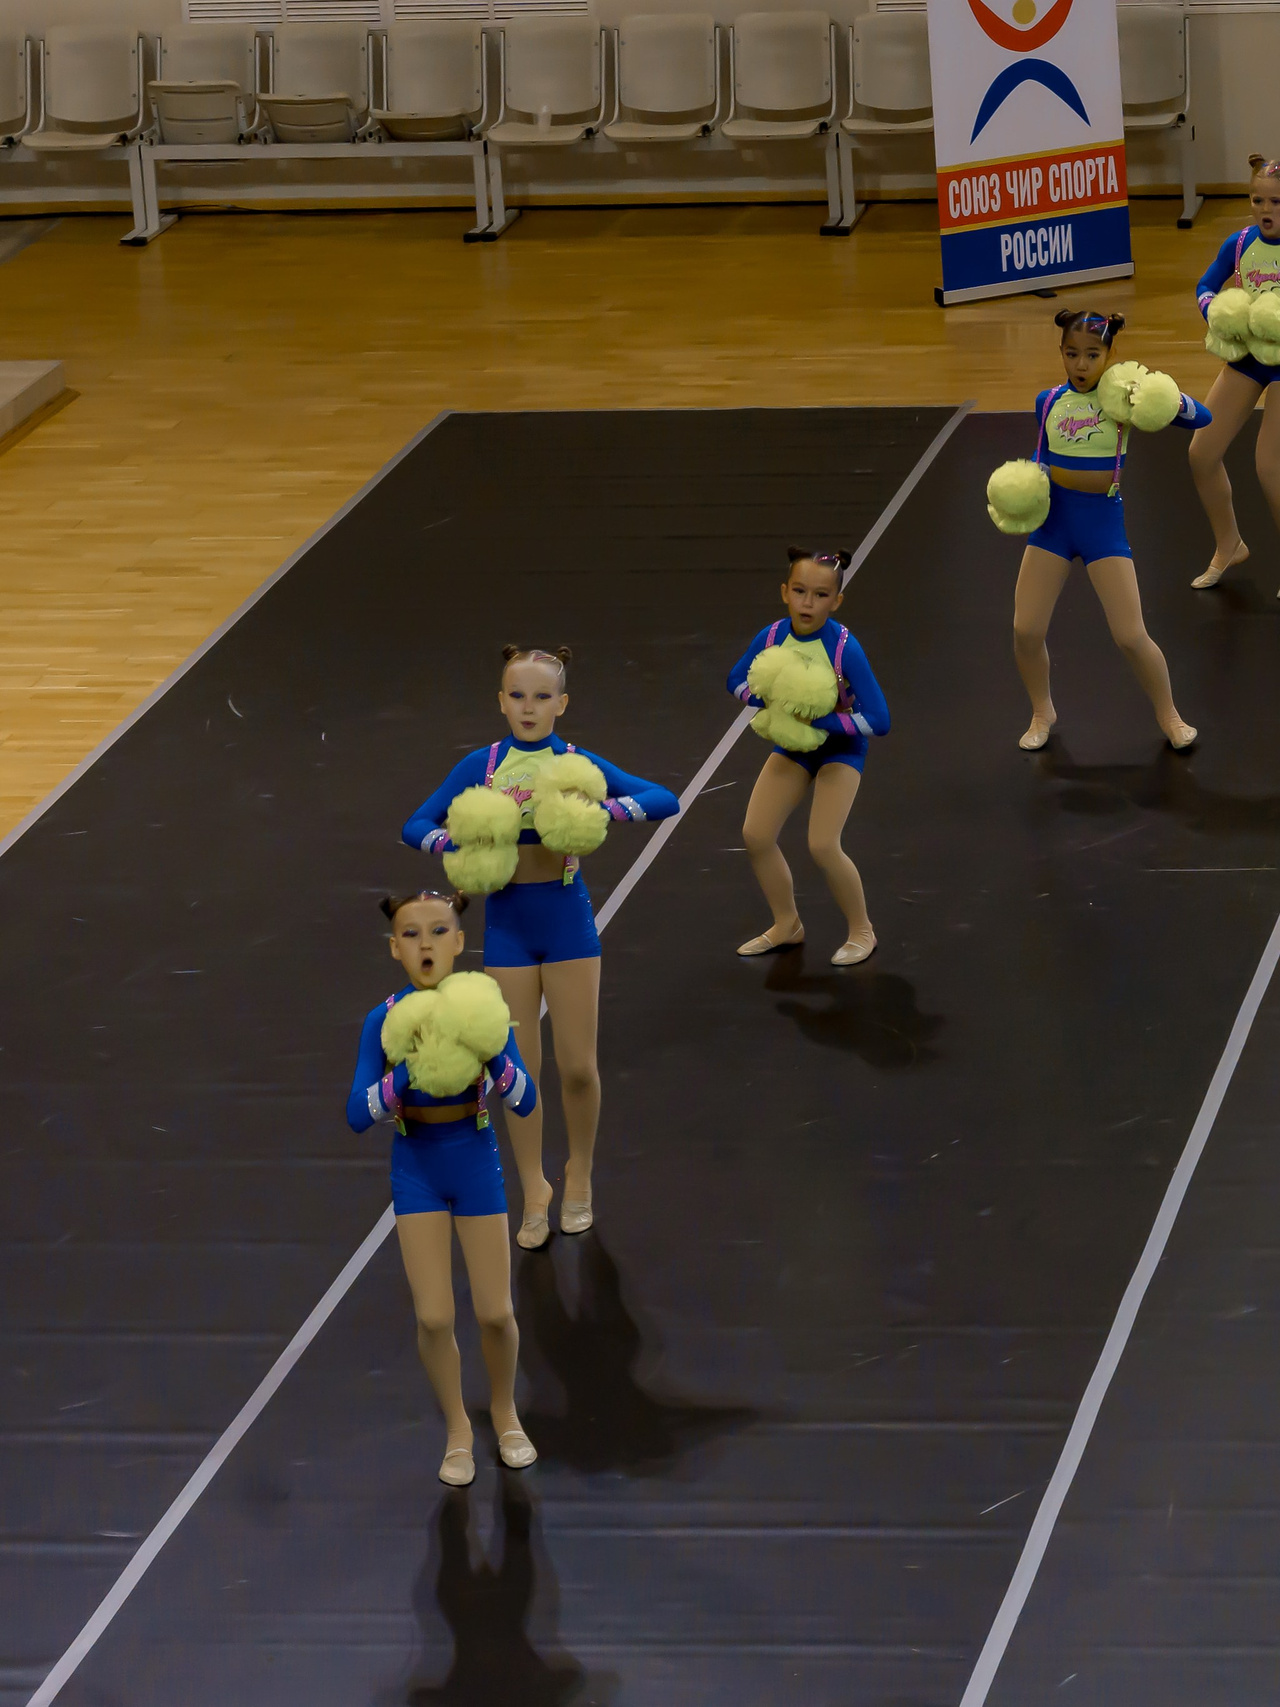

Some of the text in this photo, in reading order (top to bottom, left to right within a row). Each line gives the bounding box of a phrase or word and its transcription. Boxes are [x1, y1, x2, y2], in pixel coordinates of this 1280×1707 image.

[948, 155, 1119, 219] СОЮЗ ЧИР СПОРТА
[1000, 223, 1074, 272] РОССИИ
